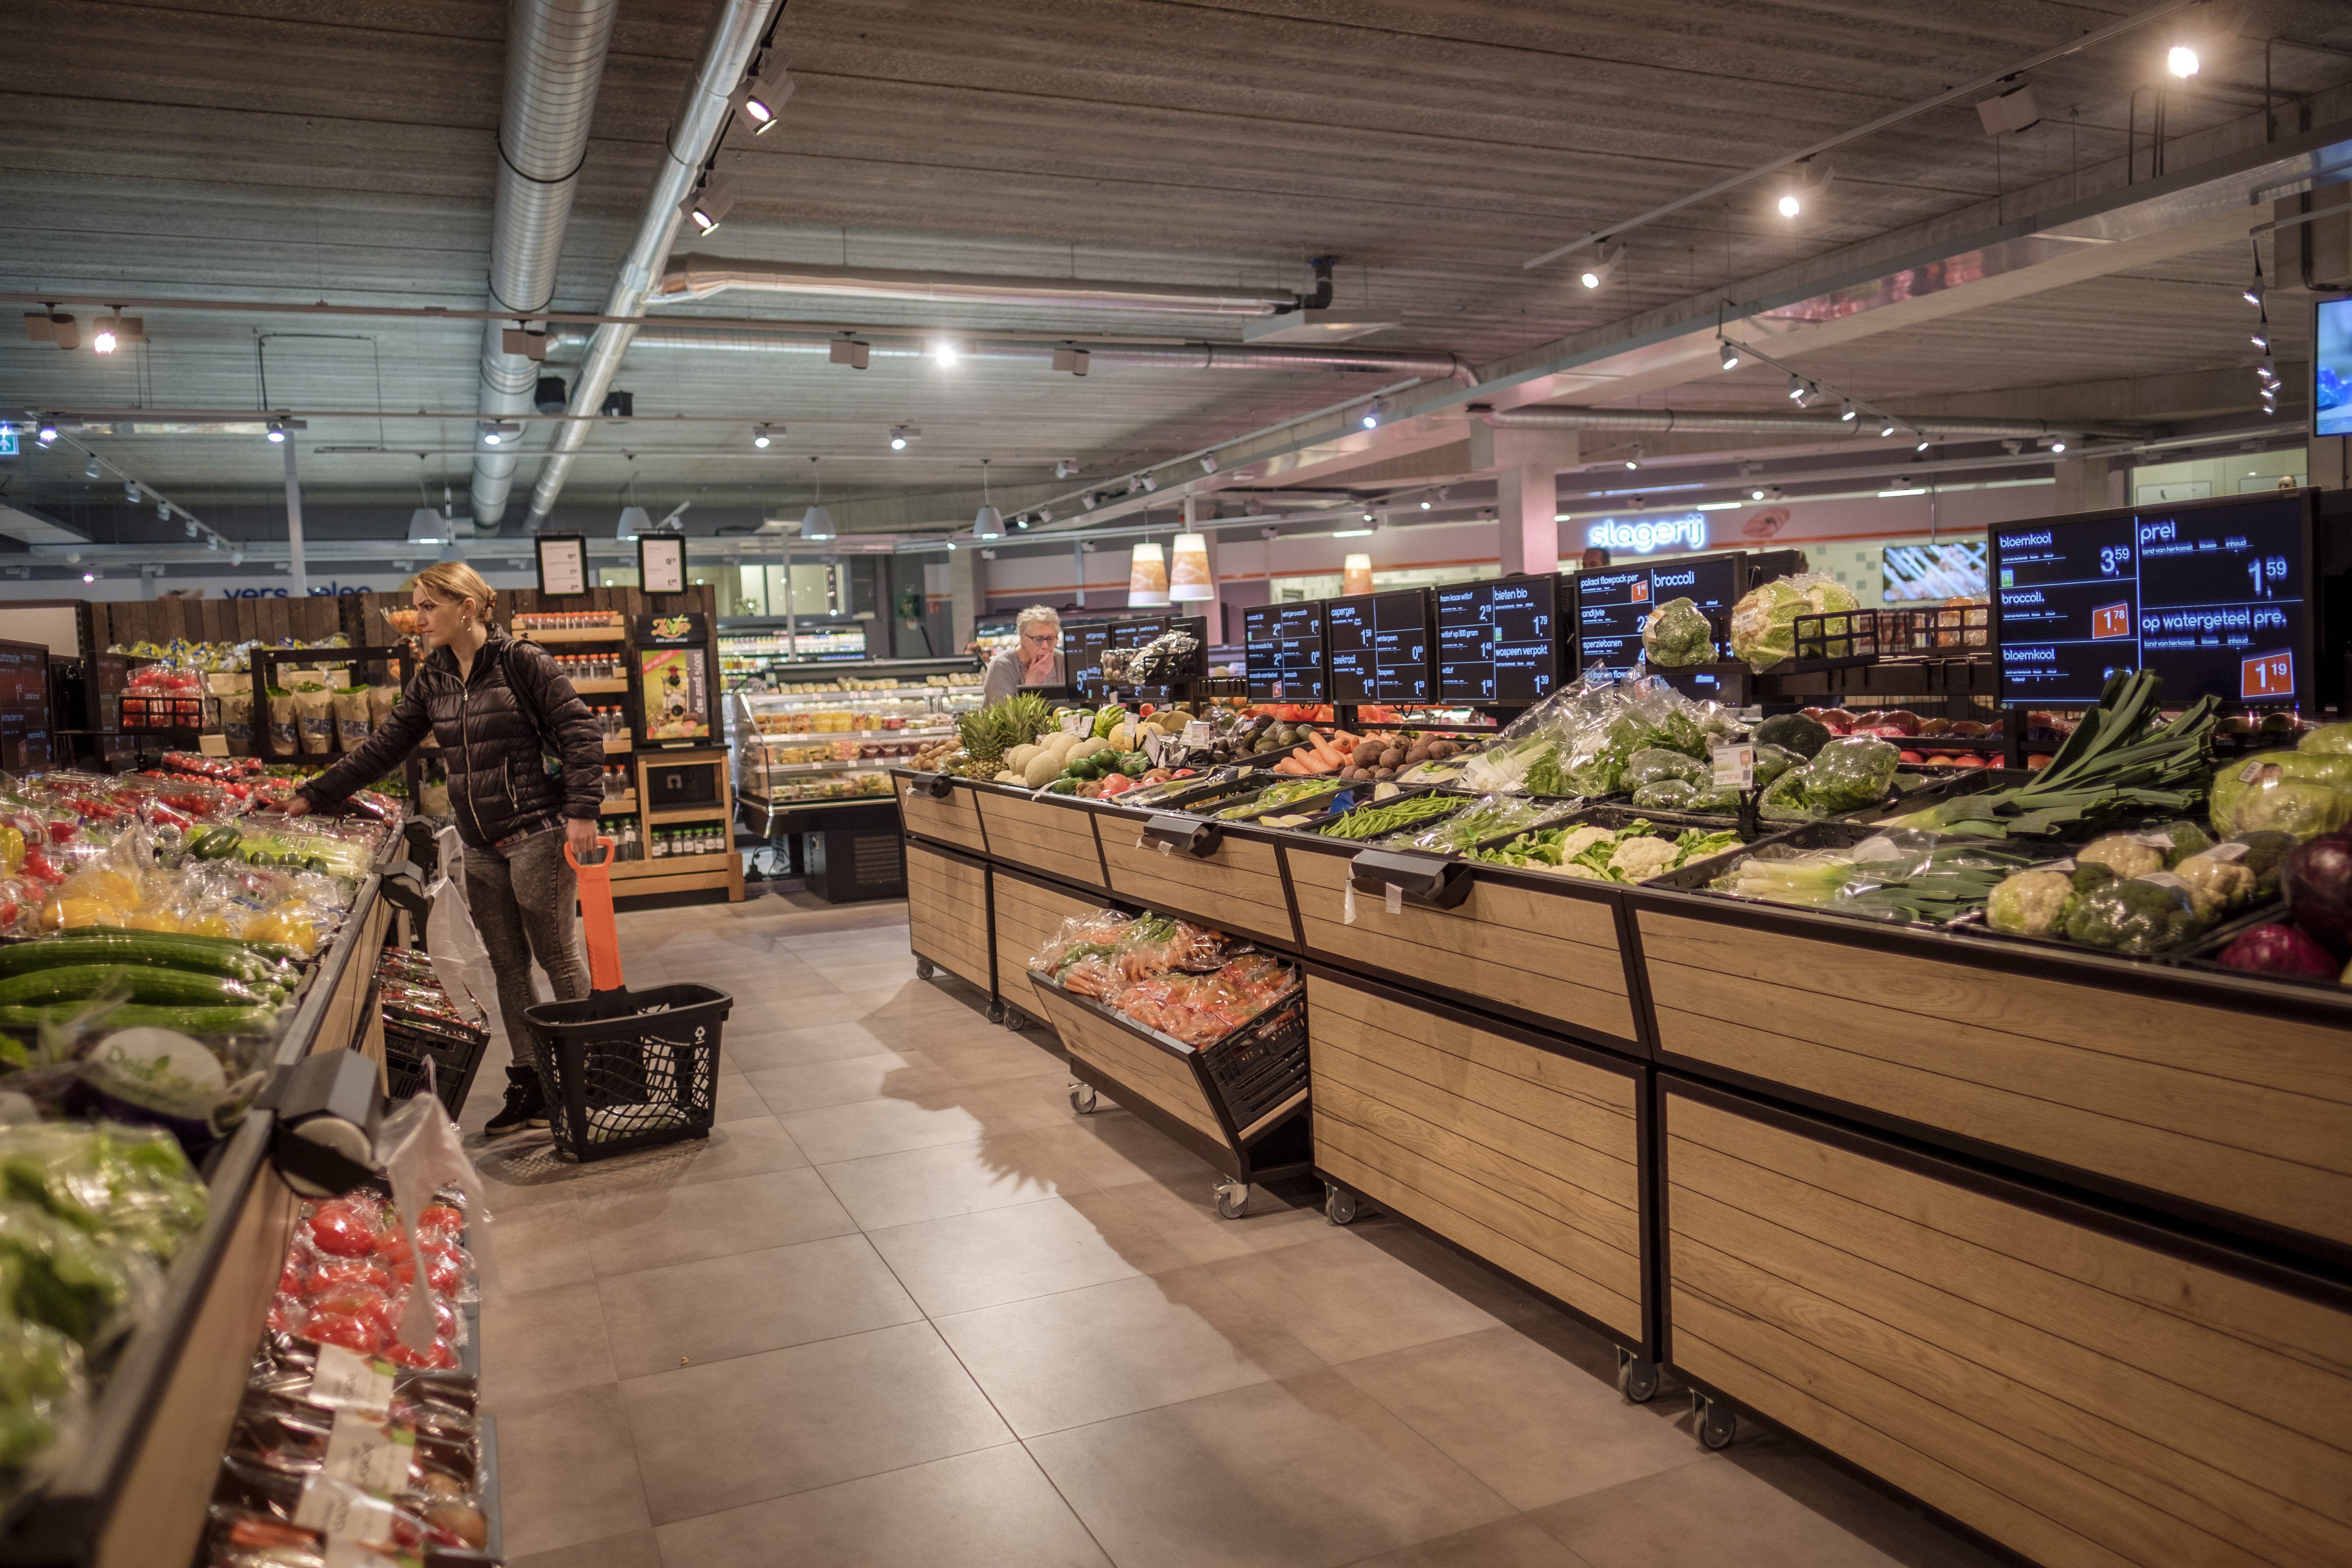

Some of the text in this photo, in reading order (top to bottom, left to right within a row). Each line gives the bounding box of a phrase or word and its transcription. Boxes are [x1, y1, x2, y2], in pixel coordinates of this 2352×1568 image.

[1590, 514, 1704, 552] slagerij
[2000, 532, 2052, 548] bloemkool
[2141, 523, 2175, 544] prei
[1654, 571, 1694, 587] broccoli
[1495, 588, 1527, 601] bieten bio
[2002, 592, 2045, 604] broccoli.
[2143, 611, 2287, 632] op watergeteel pre.
[2003, 648, 2055, 660] bloemkool
